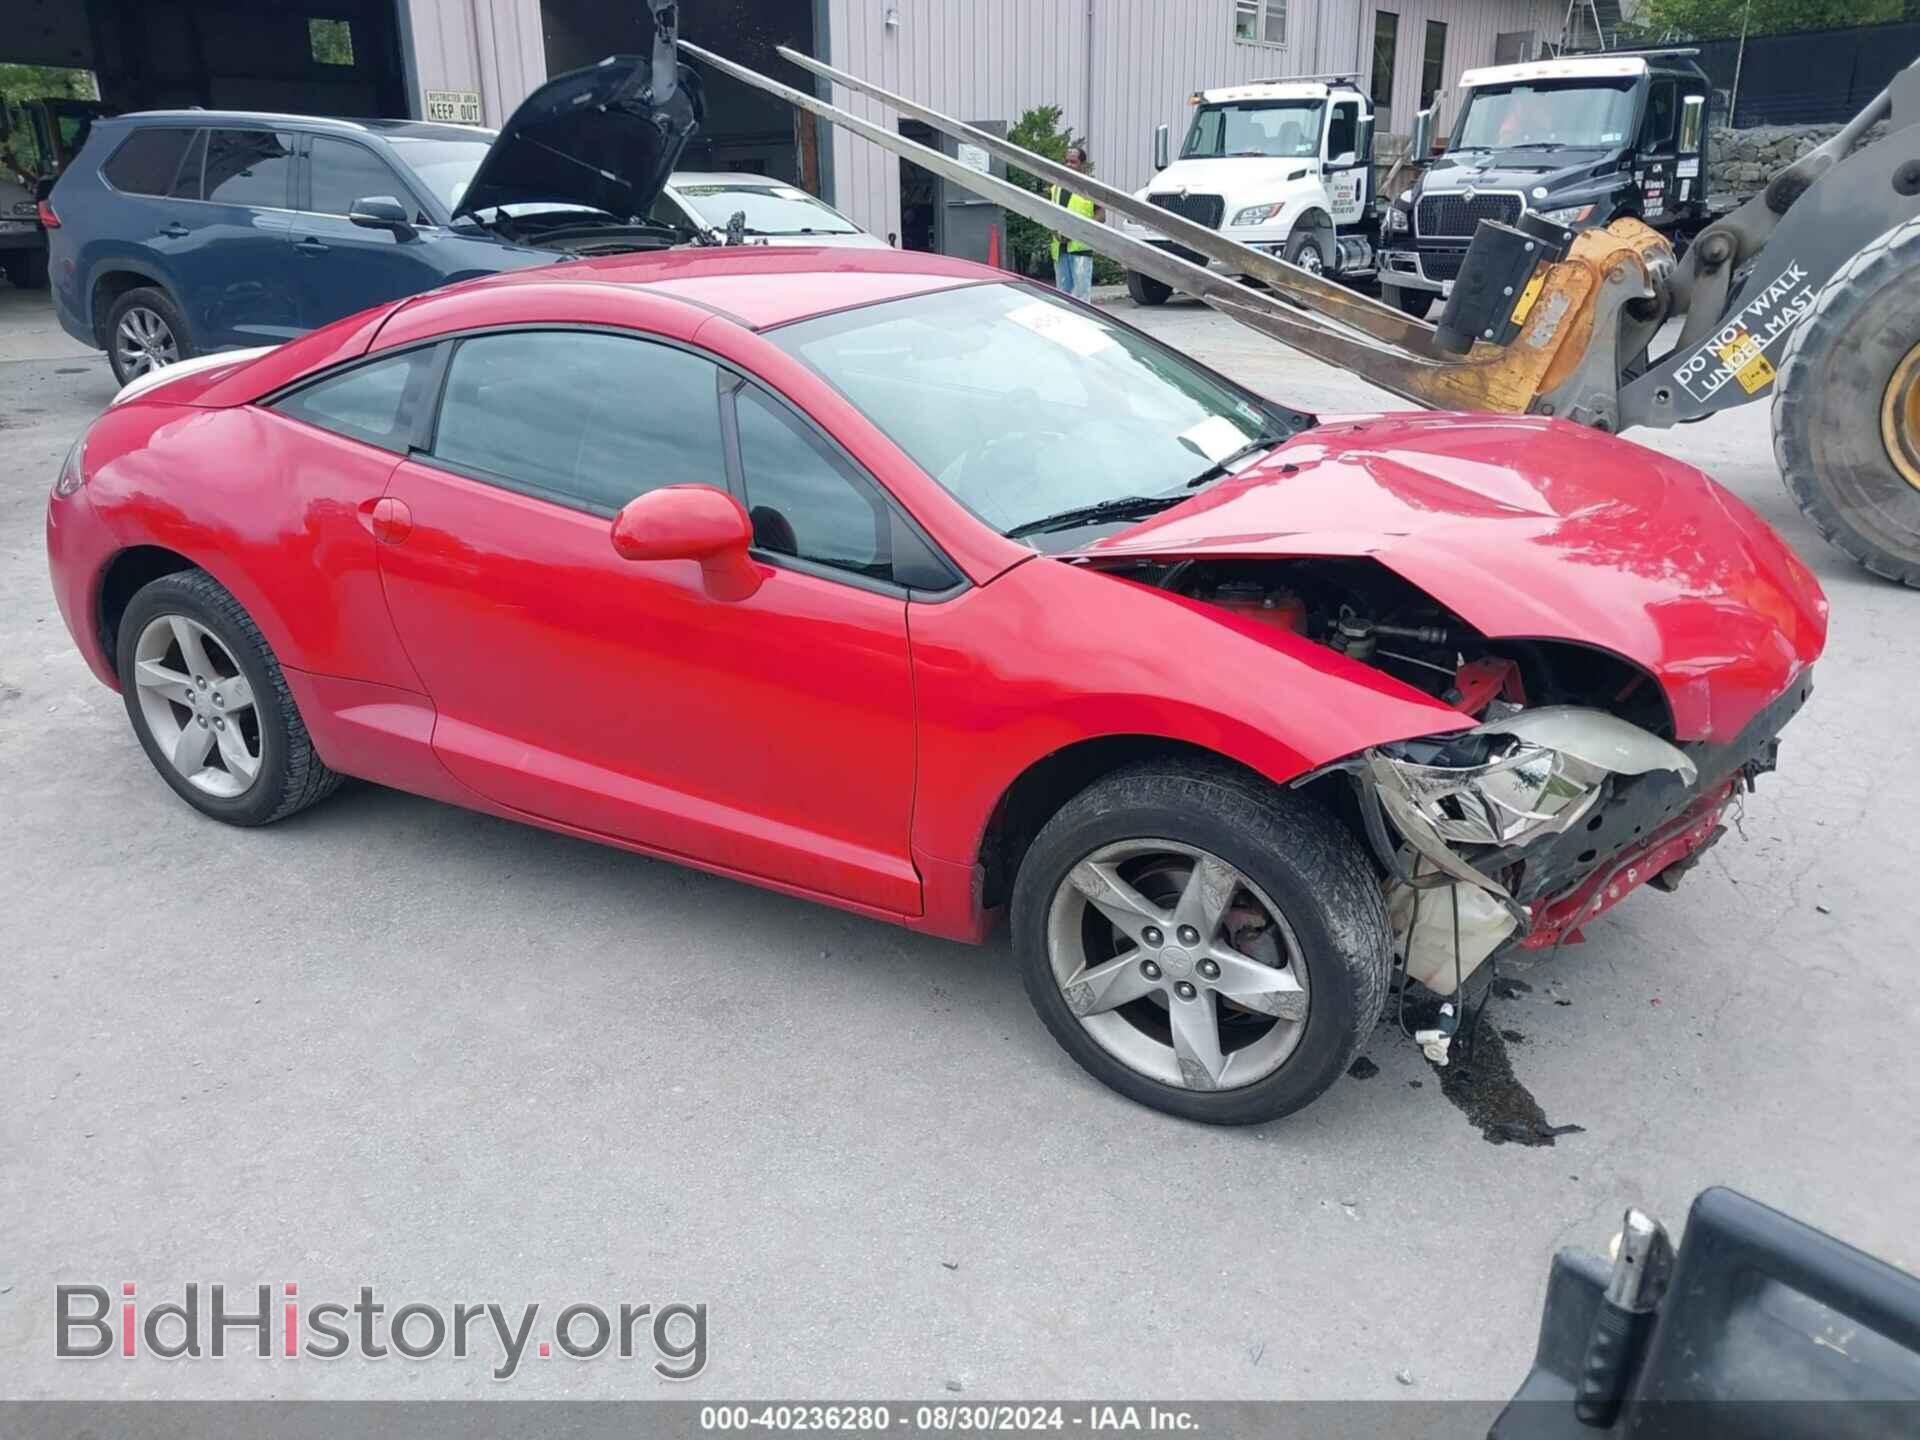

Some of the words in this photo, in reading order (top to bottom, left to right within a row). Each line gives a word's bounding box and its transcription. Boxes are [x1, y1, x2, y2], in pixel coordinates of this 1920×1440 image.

[430, 103, 454, 119] KEEP
[460, 105, 478, 120] OUT
[1677, 356, 1706, 384] DO
[1705, 315, 1748, 357] NOT
[1747, 264, 1808, 316] WALK
[1701, 333, 1768, 390] UNDER
[1764, 284, 1817, 335] MAST
